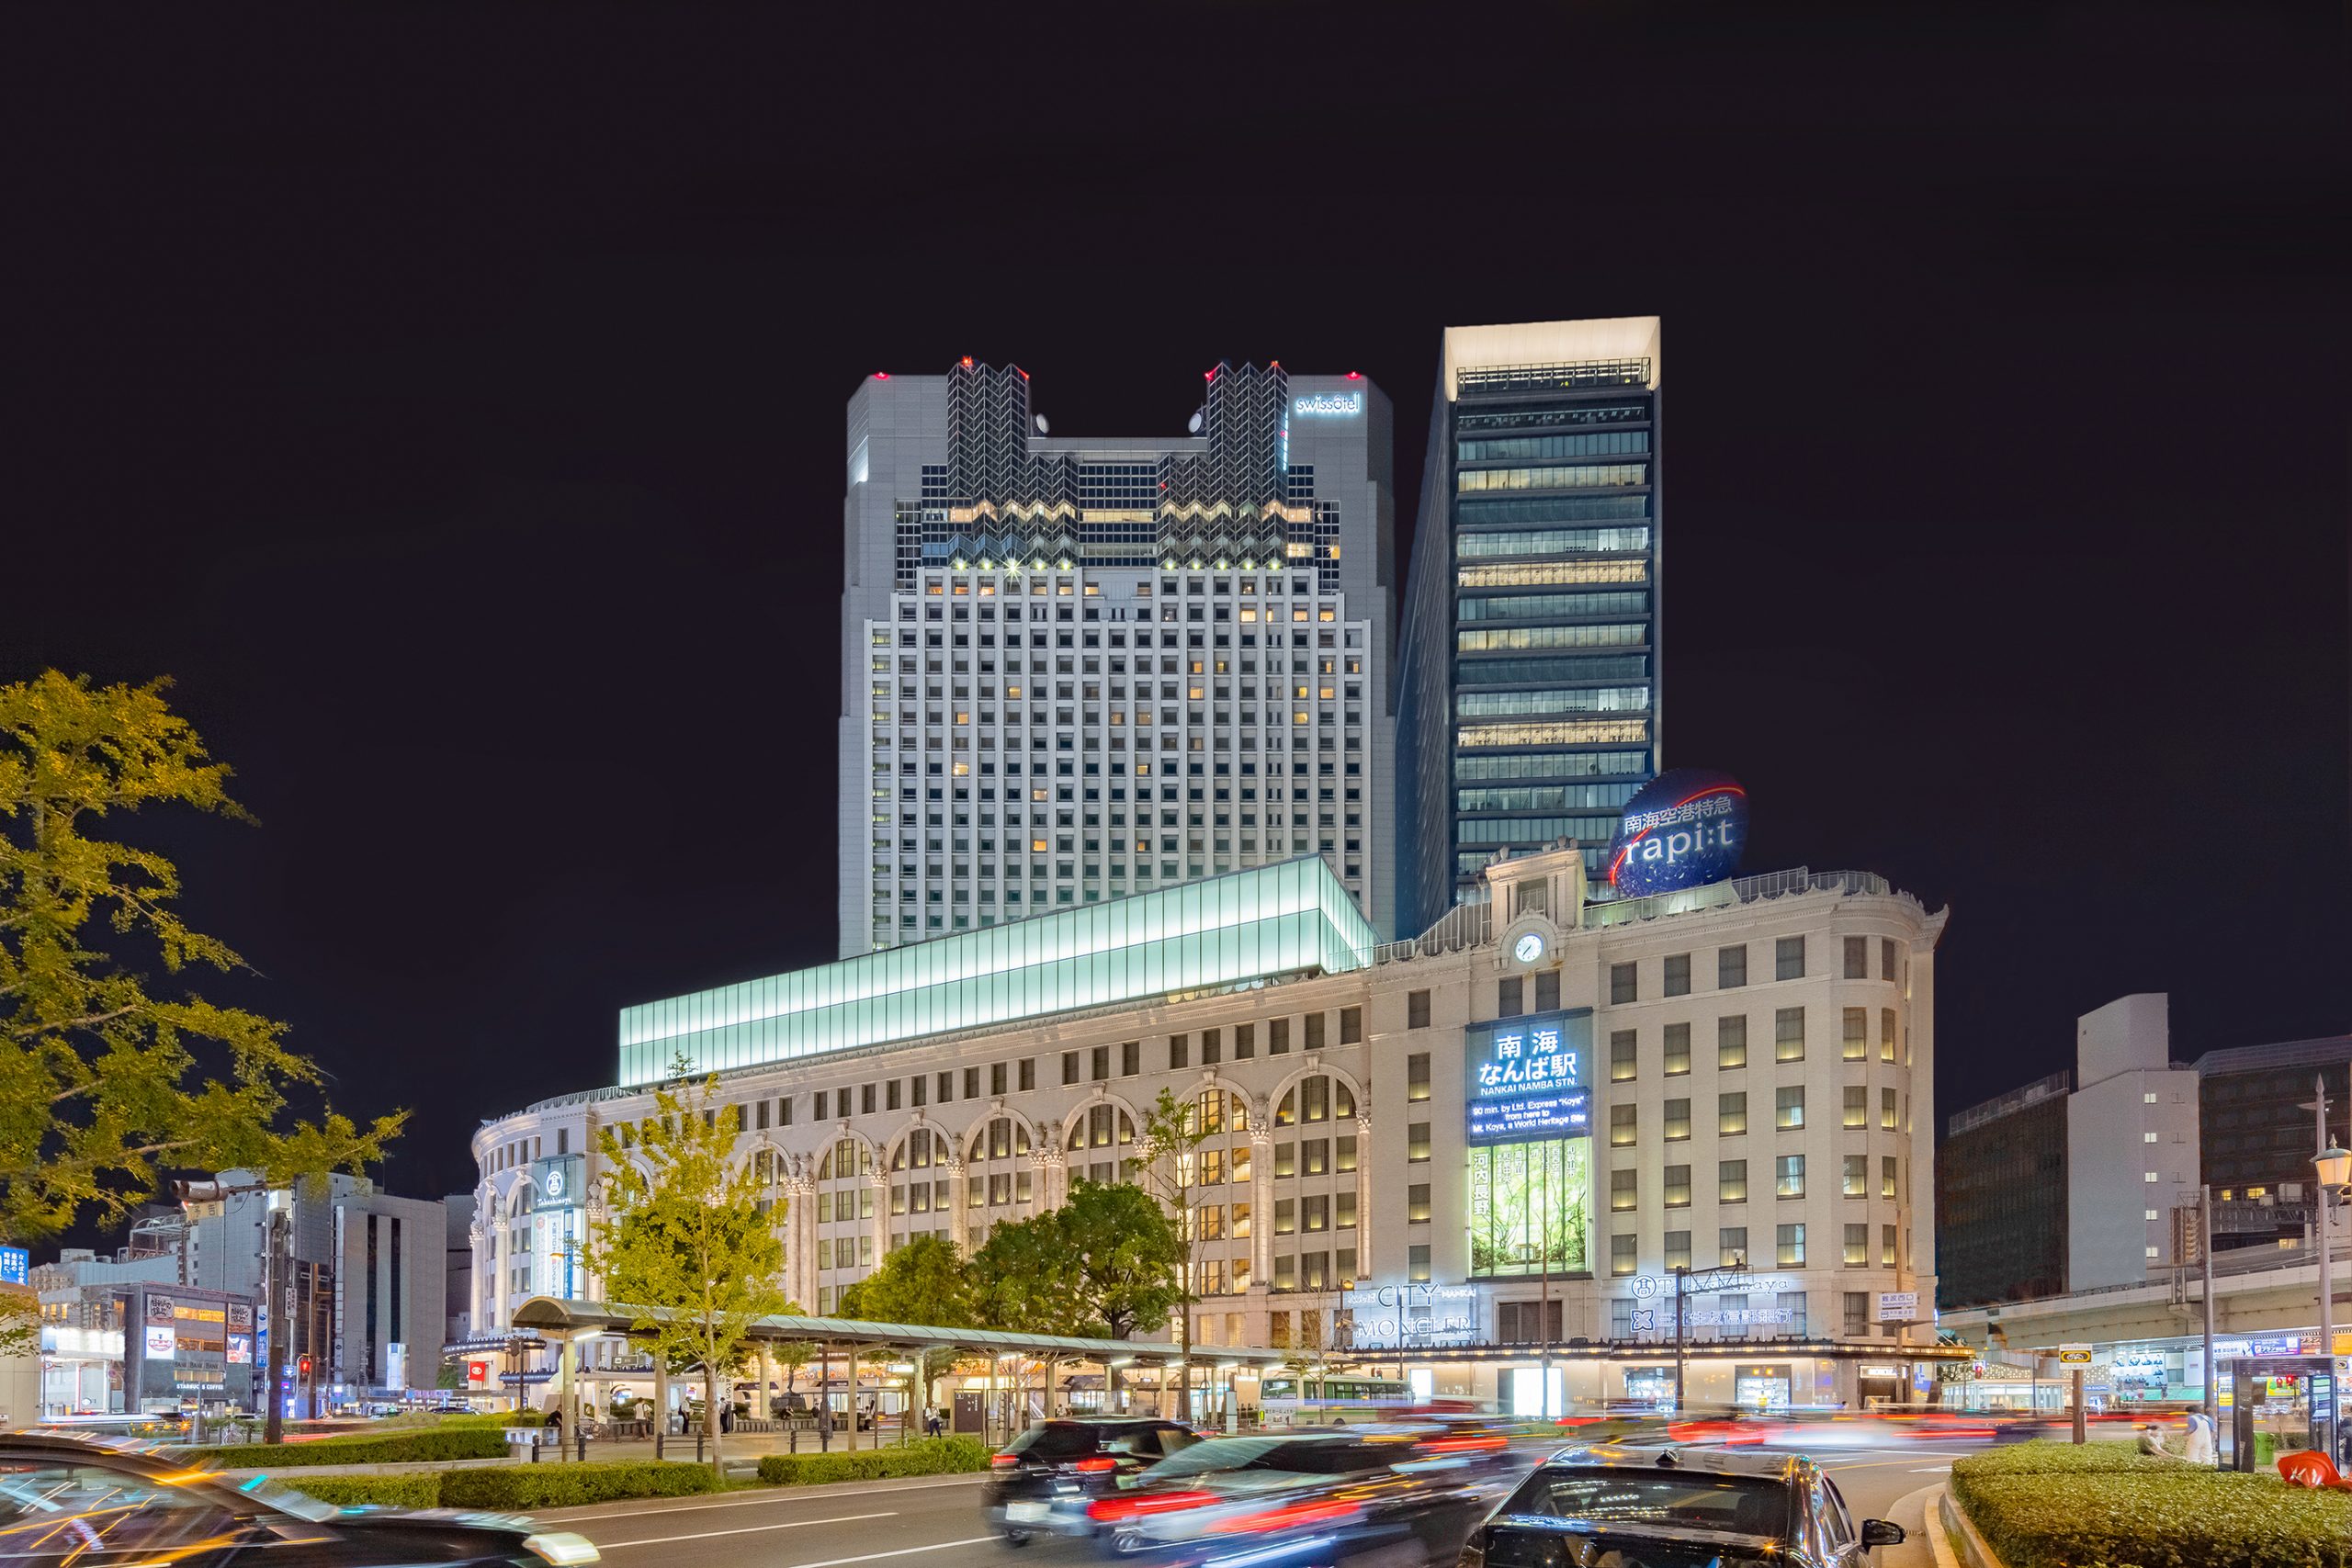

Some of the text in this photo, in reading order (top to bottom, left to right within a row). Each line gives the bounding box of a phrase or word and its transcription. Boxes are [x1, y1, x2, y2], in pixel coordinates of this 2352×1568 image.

[1296, 392, 1360, 412] swissôtel
[1624, 796, 1733, 834] 南海空港特急
[1624, 819, 1735, 865] rapi:t
[1479, 1052, 1577, 1086] なんば駅
[1480, 1077, 1577, 1096] NANKAI NAMBA STN.
[1473, 1107, 1483, 1116] 90
[1501, 1104, 1510, 1113] by
[1511, 1102, 1526, 1111] Ltd.
[1528, 1100, 1557, 1111] Express
[1505, 1112, 1522, 1122] from
[1523, 1111, 1540, 1120] here
[1473, 1124, 1484, 1133] Mt.
[1514, 1118, 1537, 1129] World
[1538, 1115, 1569, 1126] Heritage
[1474, 1153, 1490, 1215] 河内長野
[1377, 1282, 1441, 1309] CITY
[1353, 1316, 1474, 1338] MONCLER
[258, 1336, 266, 1364] 新生銀行
